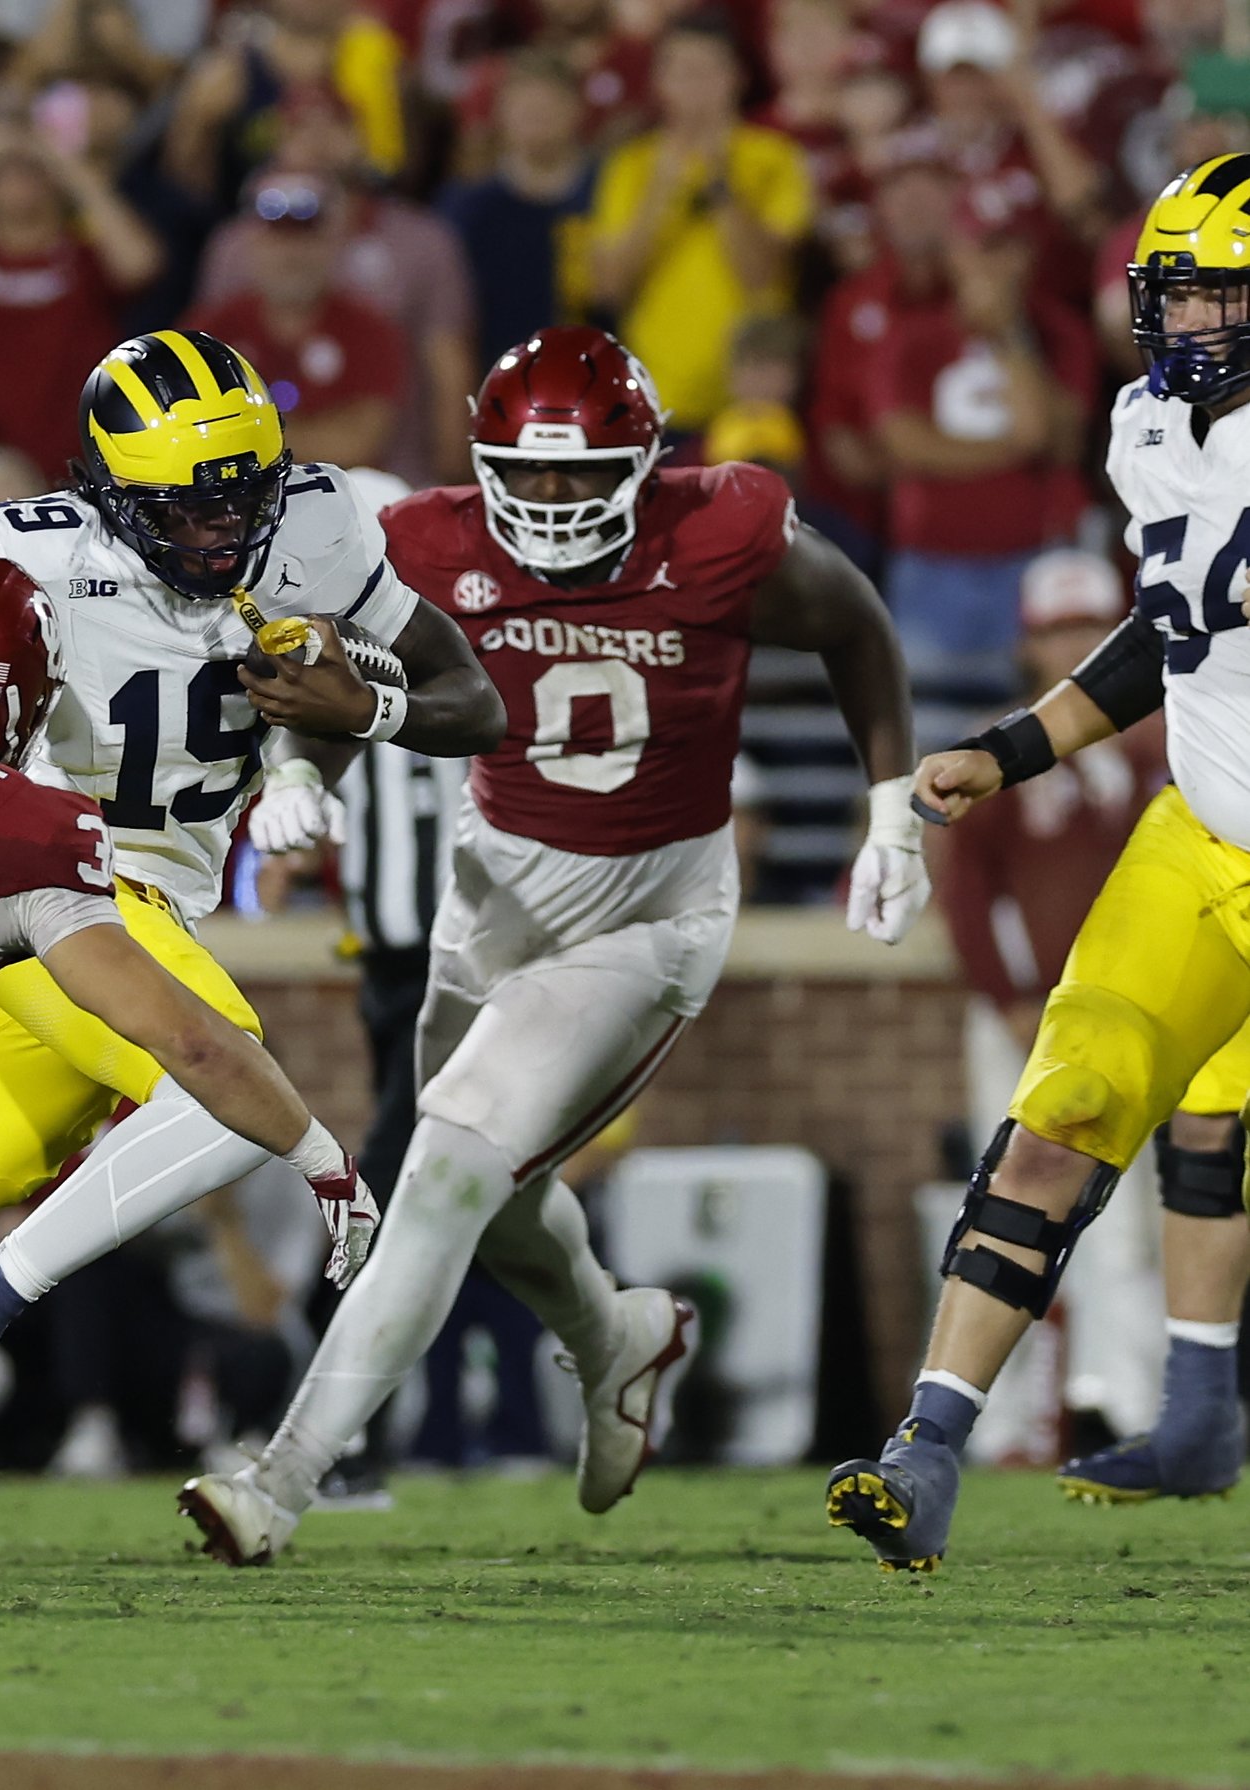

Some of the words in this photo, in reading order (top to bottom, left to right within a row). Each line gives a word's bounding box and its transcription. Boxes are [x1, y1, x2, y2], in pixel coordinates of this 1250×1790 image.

[220, 465, 238, 480] M
[381, 694, 393, 721] M
[526, 658, 650, 793] 0
[100, 659, 272, 832] 19
[76, 813, 115, 888] 3
